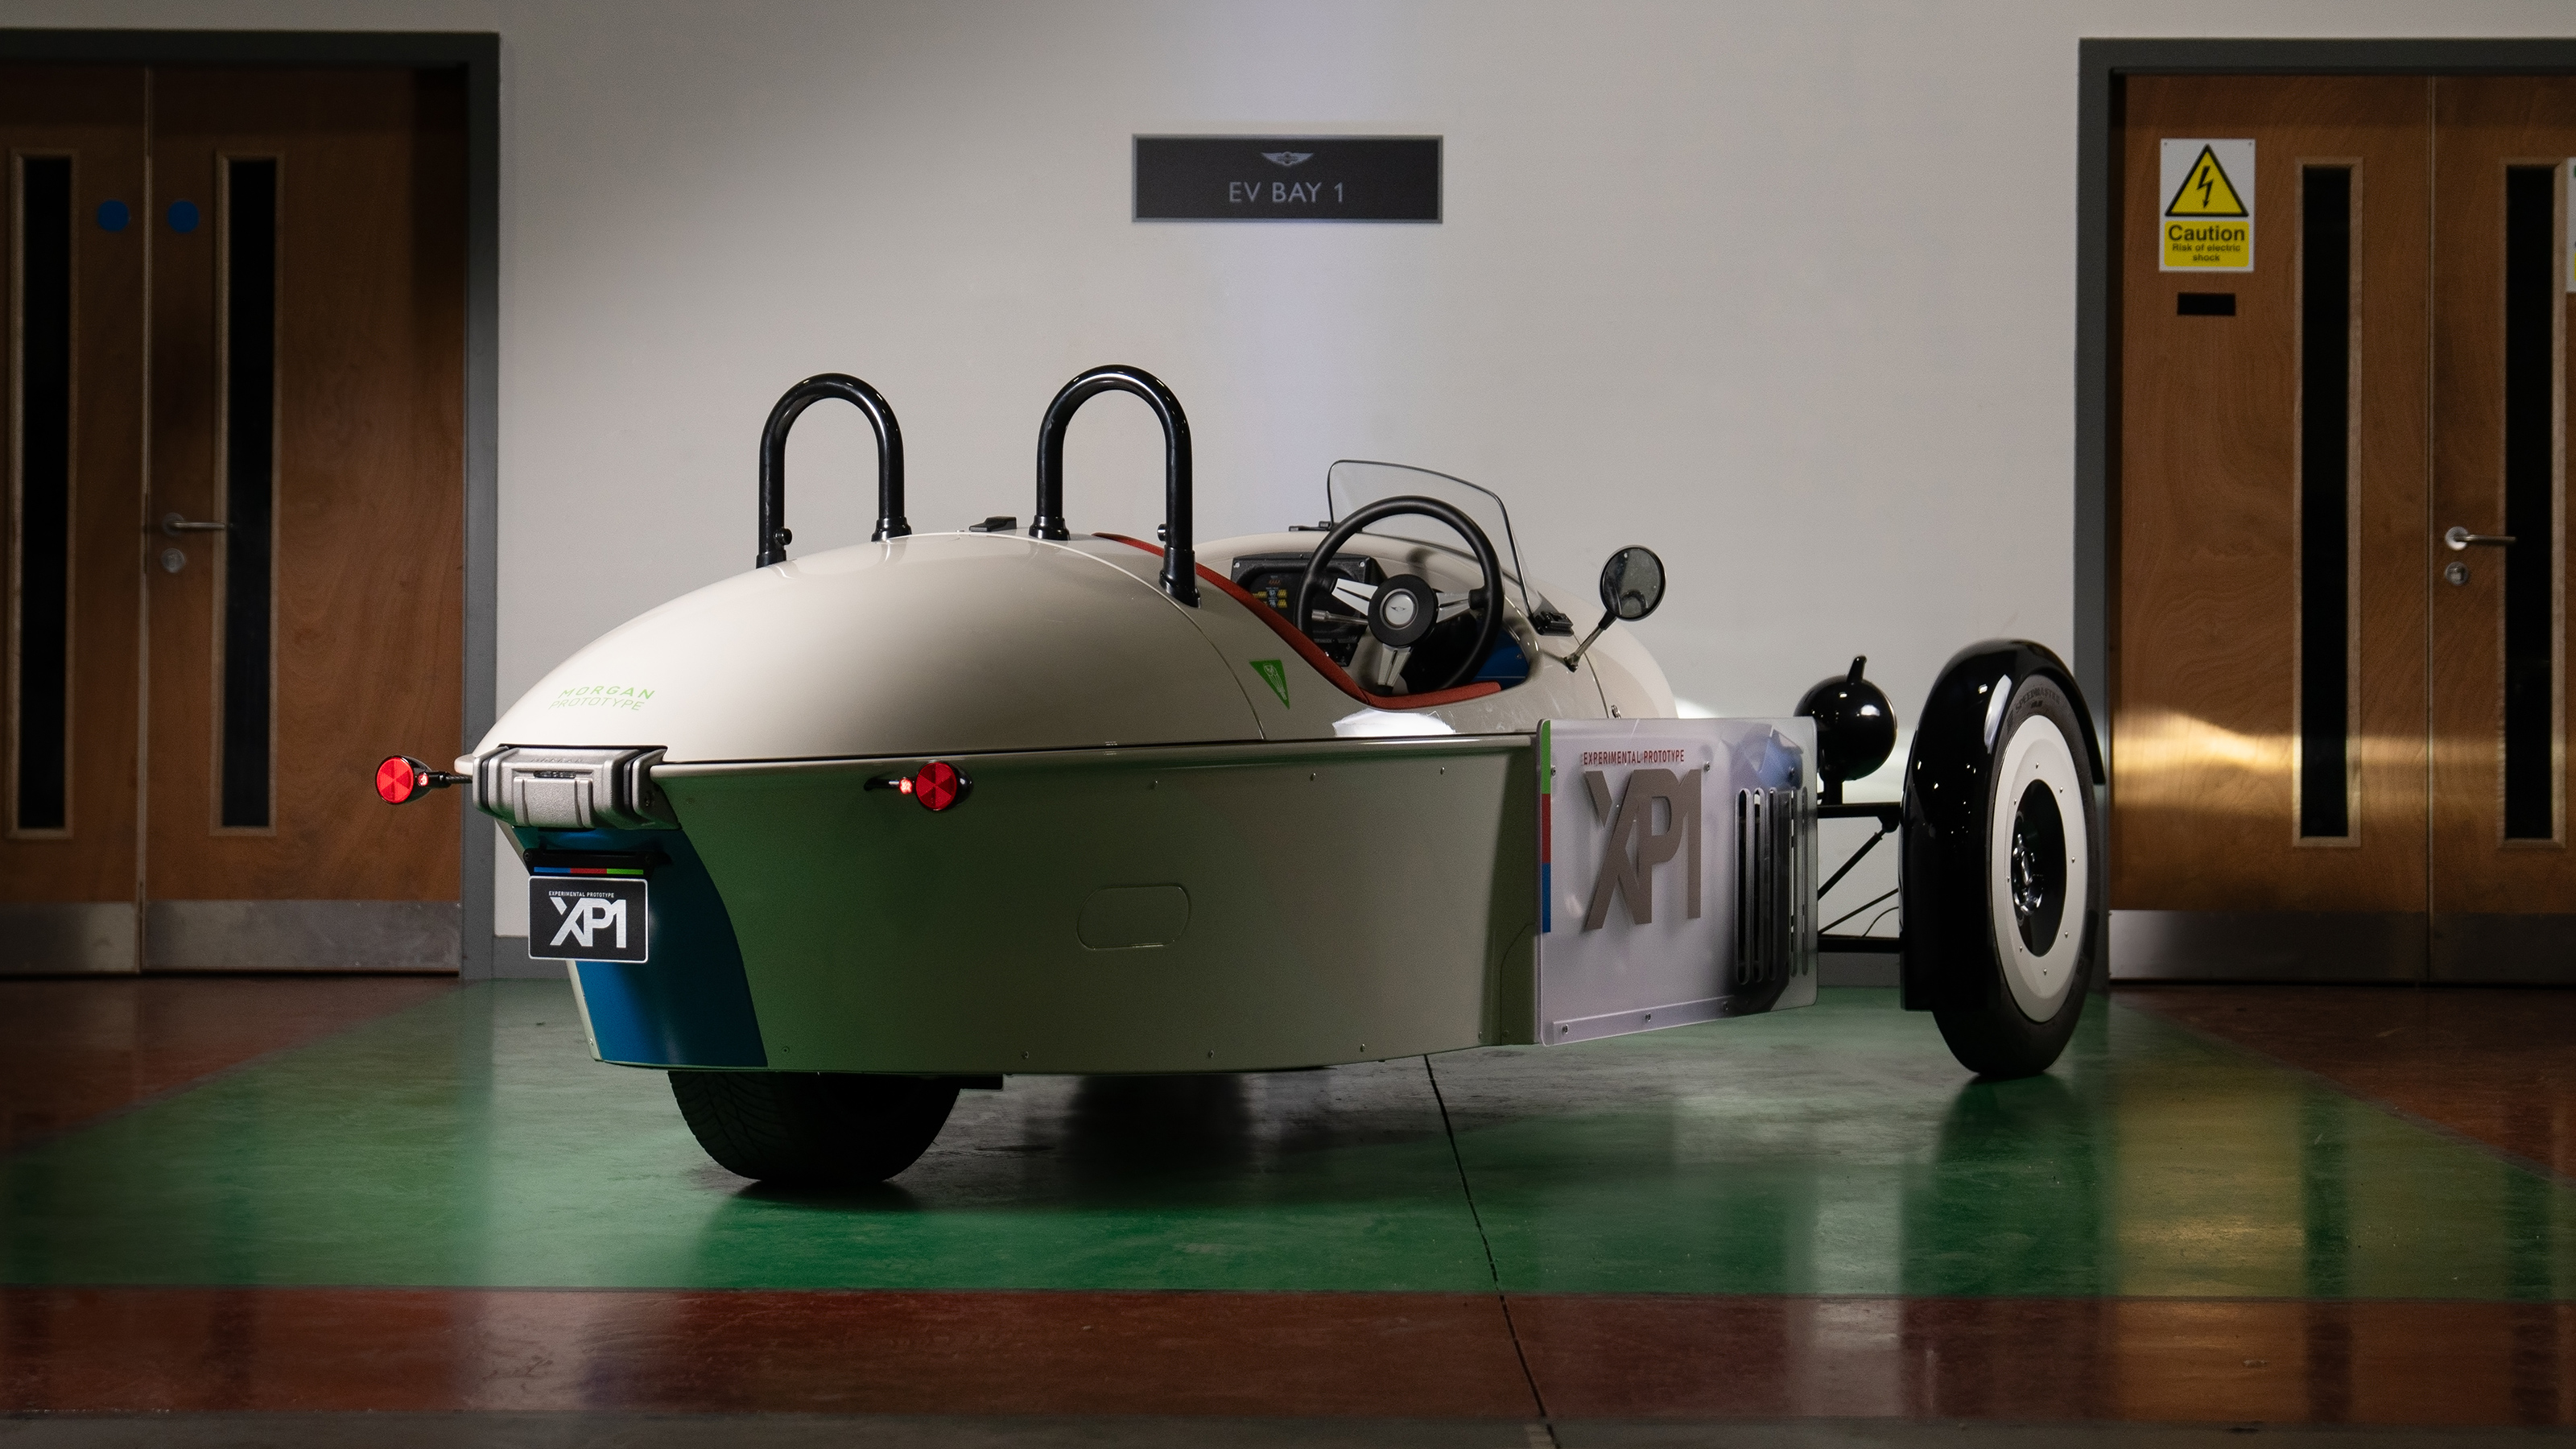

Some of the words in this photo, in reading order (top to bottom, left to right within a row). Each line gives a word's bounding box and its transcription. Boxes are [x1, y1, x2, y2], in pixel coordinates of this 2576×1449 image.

[1228, 182, 1261, 203] EV
[1272, 182, 1322, 203] BAY
[1334, 182, 1344, 203] 1
[2168, 224, 2245, 242] Caution
[2172, 243, 2192, 252] Risk
[2194, 243, 2205, 252] of
[2207, 243, 2241, 252] electric
[2192, 254, 2220, 262] shock
[558, 685, 655, 700] MORGAN
[547, 696, 645, 711] PROTOTYPE
[1583, 751, 1641, 766] EXPERIMENTAL
[1643, 749, 1685, 763] PROTOTYPE
[1583, 768, 1702, 932] XP1
[549, 896, 627, 948] XP1
